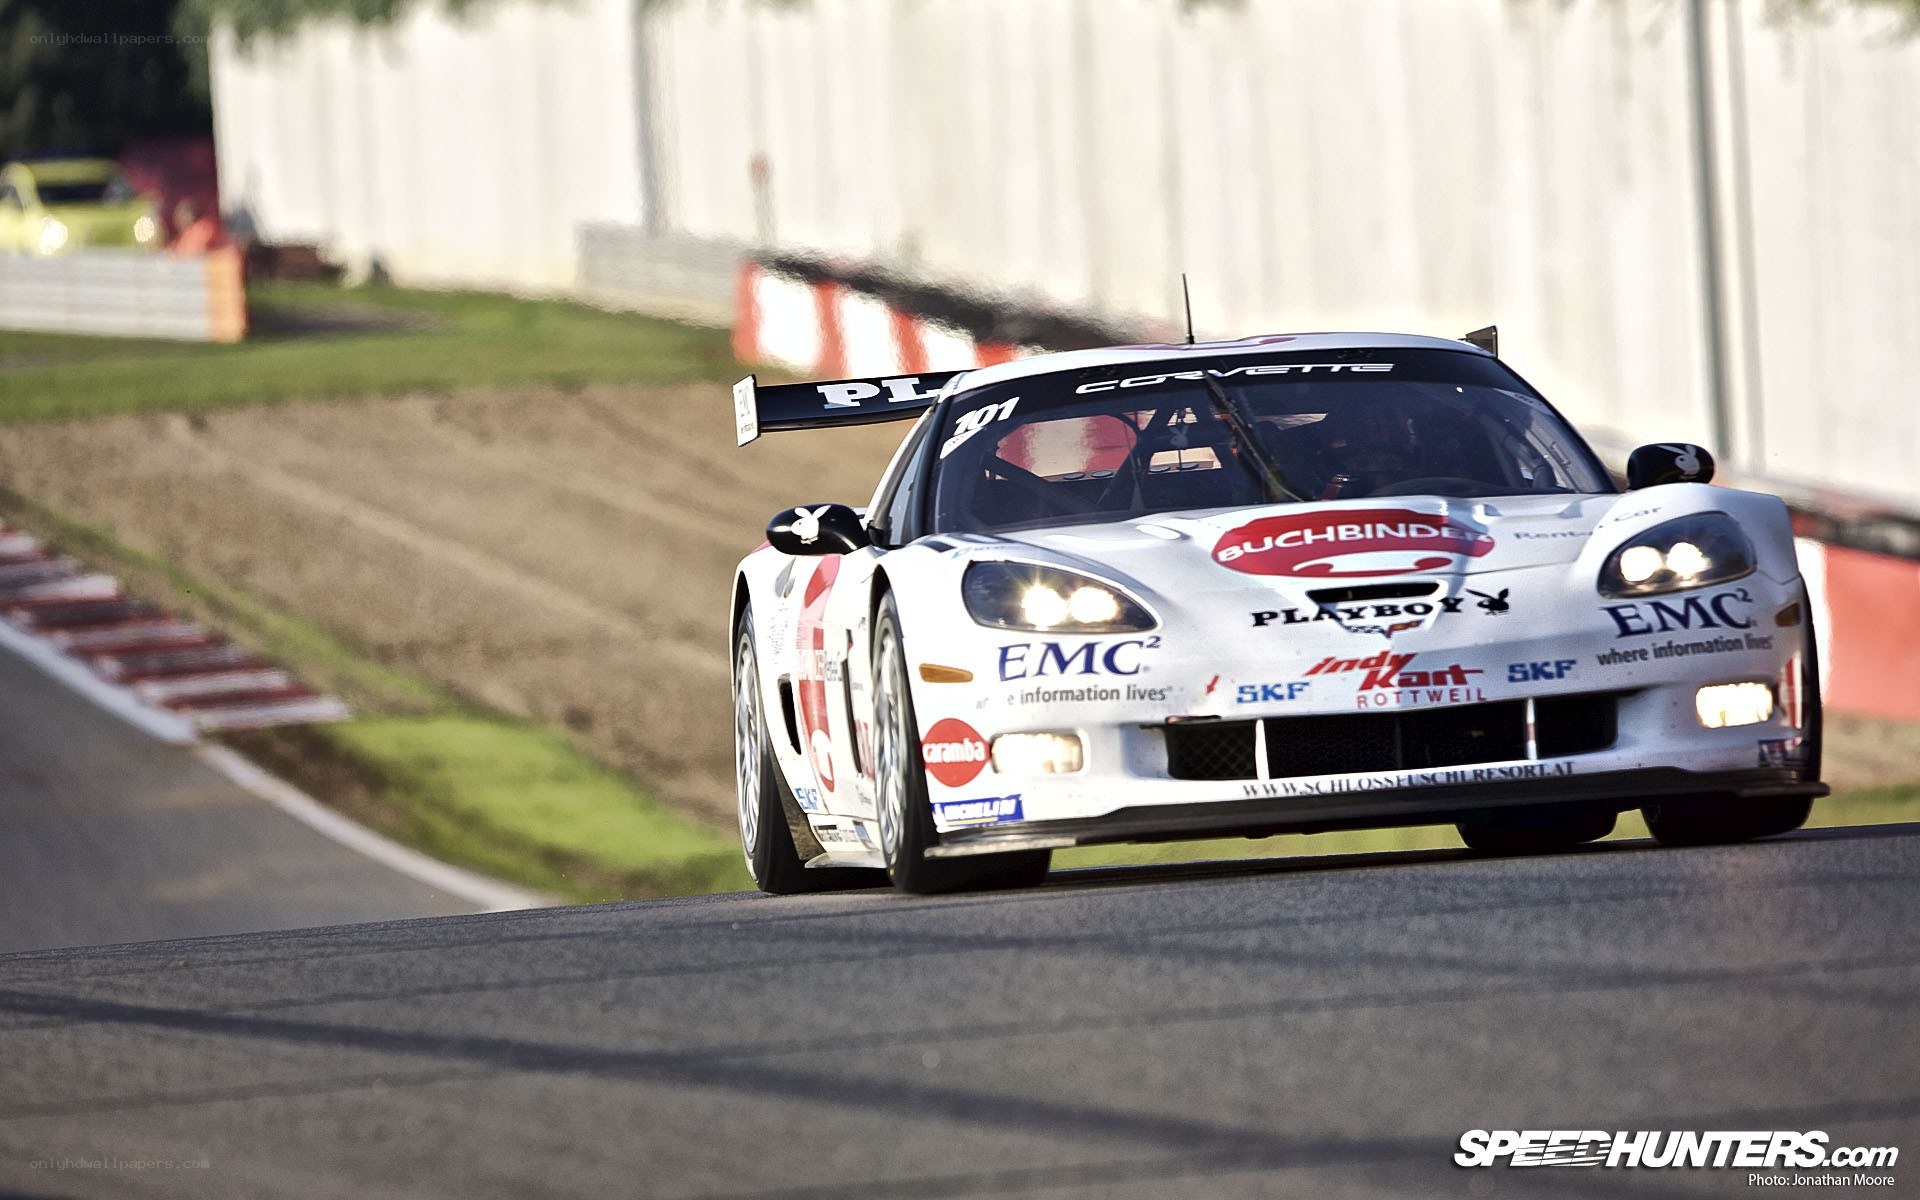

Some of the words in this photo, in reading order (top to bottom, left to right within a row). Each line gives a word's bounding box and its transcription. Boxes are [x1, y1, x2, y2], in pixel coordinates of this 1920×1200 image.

[1075, 363, 1395, 394] CORVETTE
[954, 396, 1020, 436] 101
[1251, 597, 1465, 627] PLAYBOY
[1594, 648, 1649, 667] where
[1652, 635, 1744, 659] information
[1358, 664, 1484, 691] Kart
[1508, 658, 1577, 682] SKF
[1021, 685, 1120, 704] information
[1126, 683, 1166, 701] lives
[1236, 682, 1311, 704] SKF
[1356, 687, 1487, 709] ROTTWEIL
[922, 737, 986, 764] caramba
